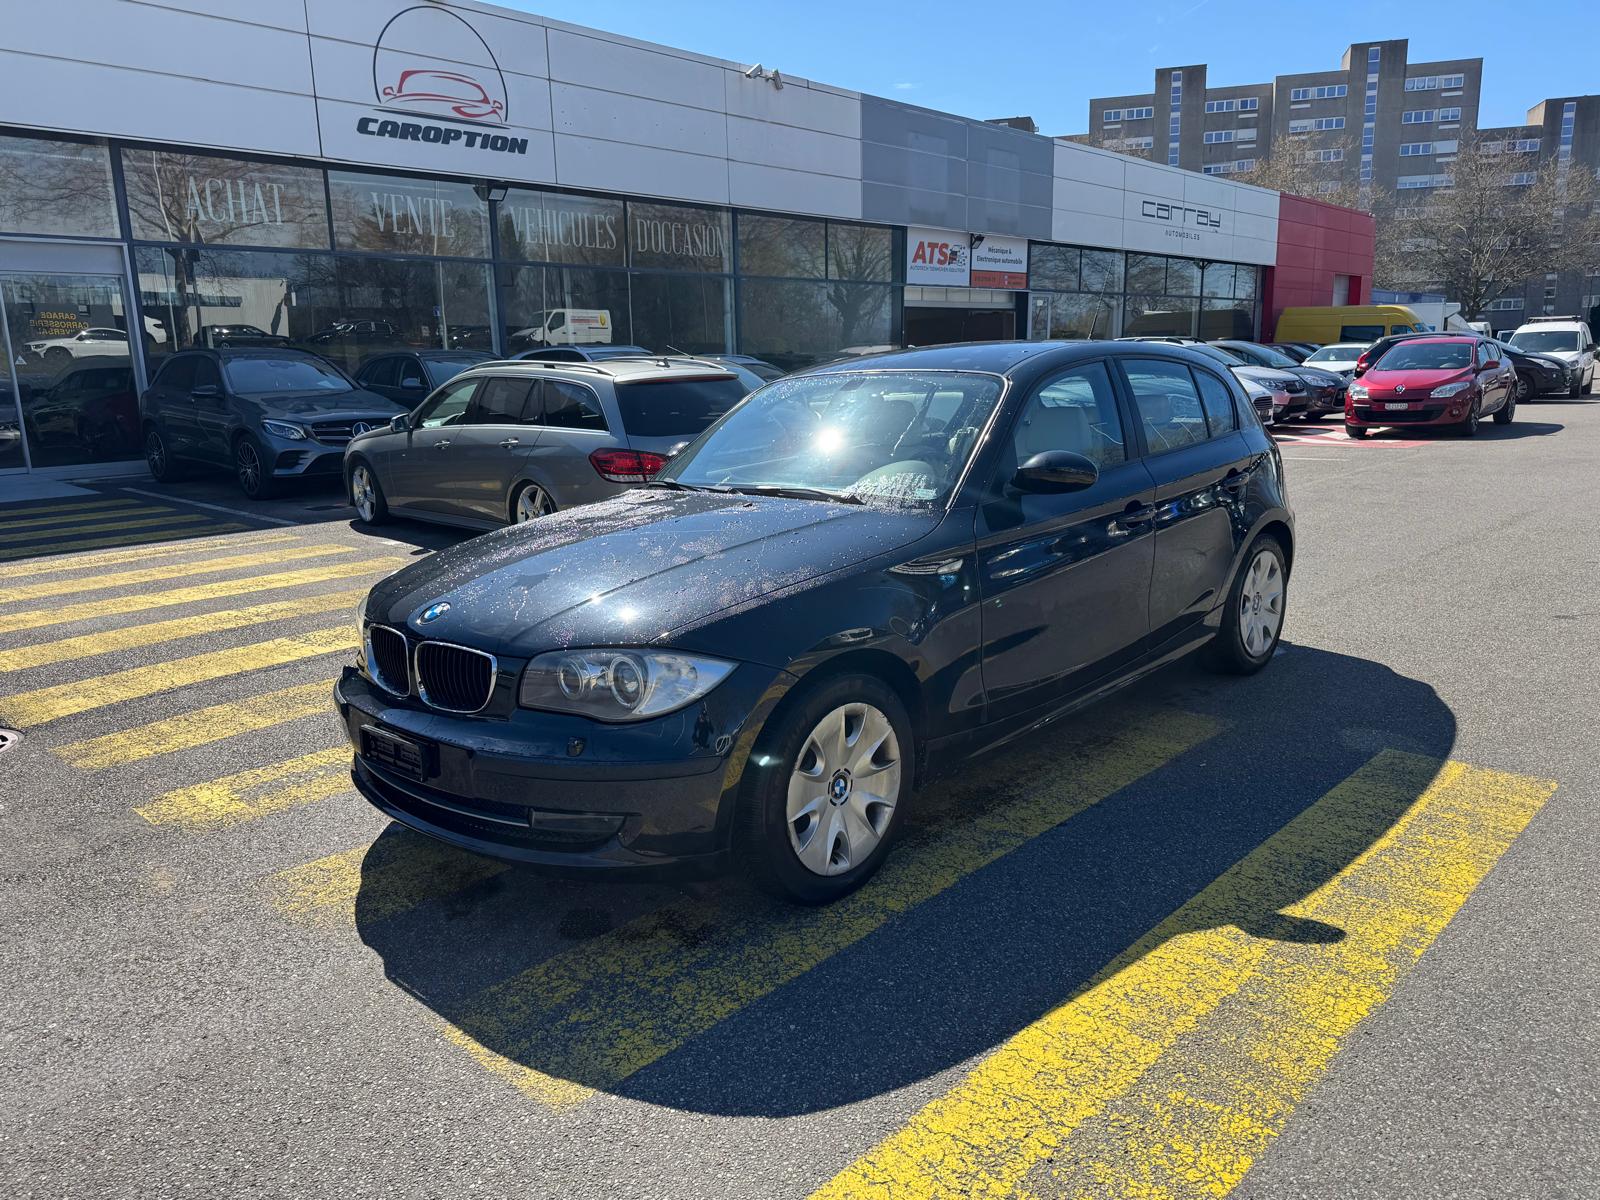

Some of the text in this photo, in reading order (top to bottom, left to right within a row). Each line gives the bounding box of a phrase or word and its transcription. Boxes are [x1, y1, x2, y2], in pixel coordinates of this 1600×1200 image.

[356, 117, 529, 155] CAROPTION
[186, 175, 727, 258] ACHAT VENTE VEHICULES D'OCCASION
[1164, 229, 1200, 241] AUTOMOBILES
[911, 240, 950, 266] ATS
